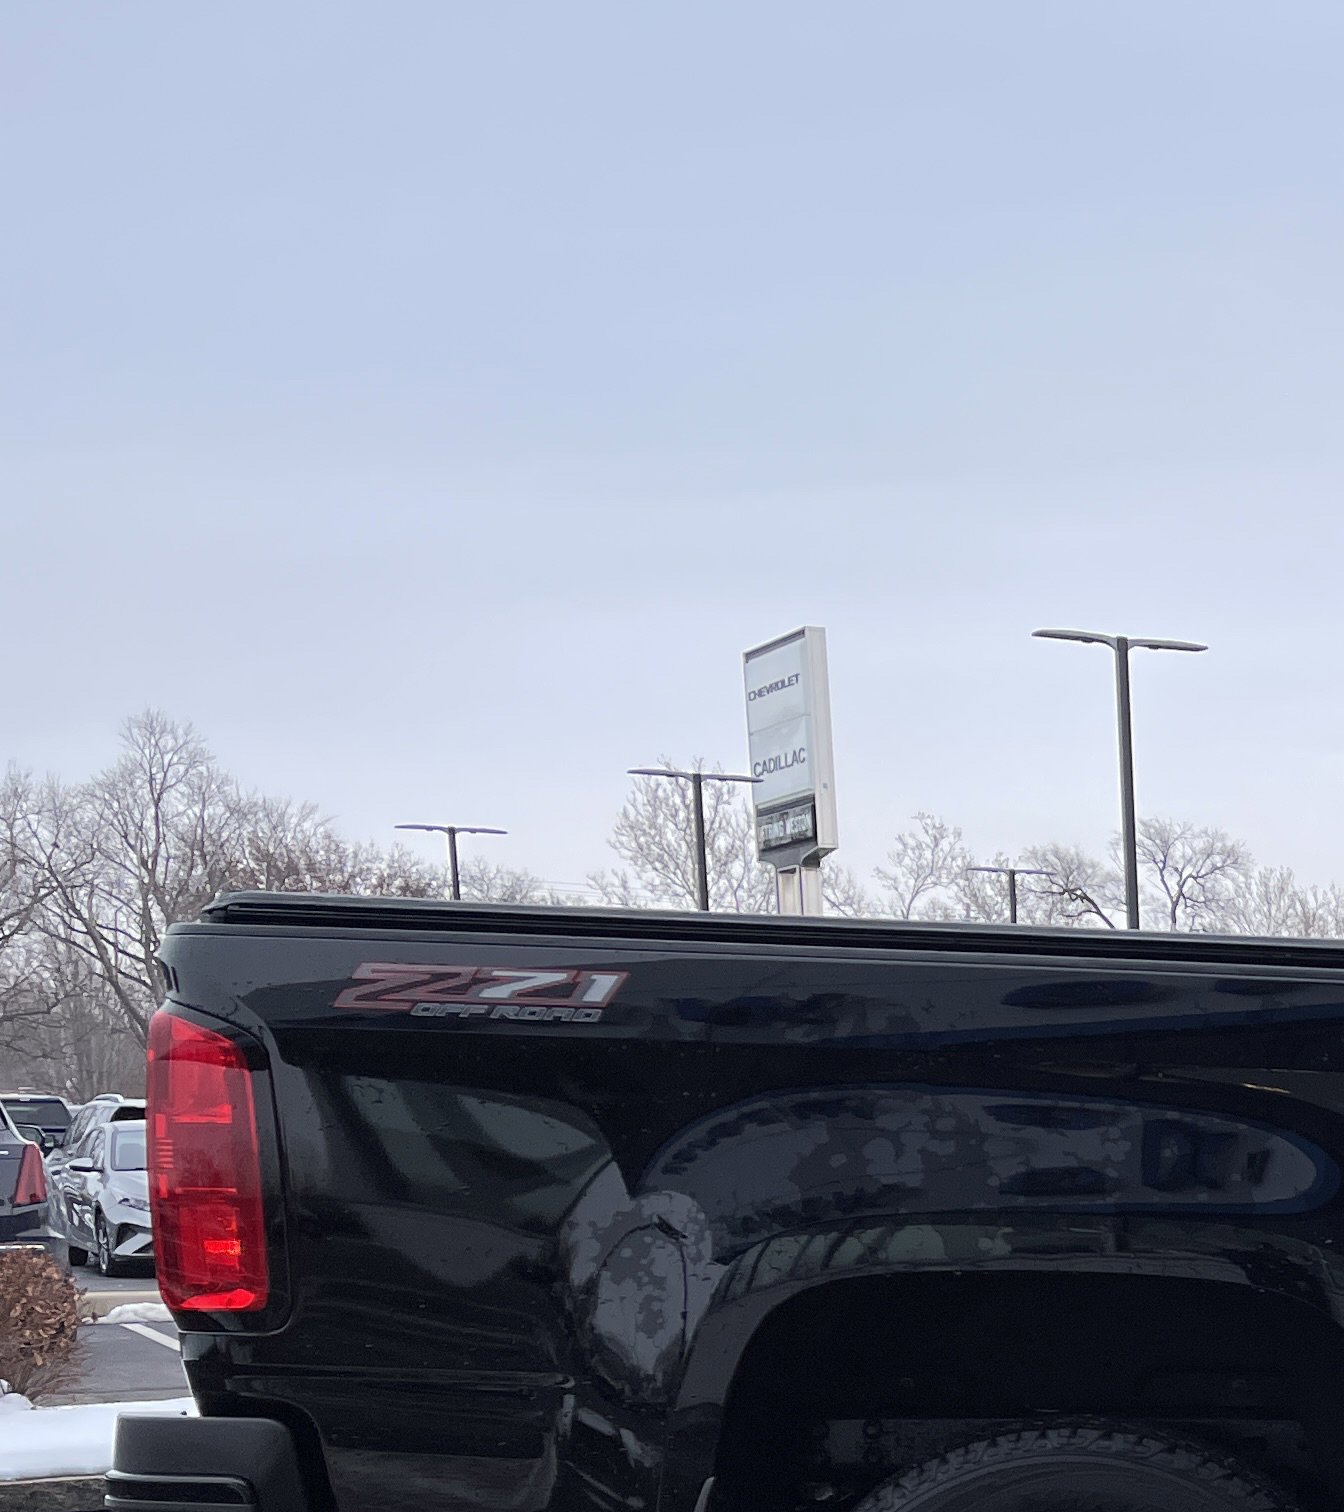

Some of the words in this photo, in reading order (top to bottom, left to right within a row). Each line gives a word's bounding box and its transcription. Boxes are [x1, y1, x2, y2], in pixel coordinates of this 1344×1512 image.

[748, 673, 800, 701] CHEVROLET
[753, 748, 806, 777] CADILLAC
[332, 961, 631, 1011] Z71
[410, 1002, 489, 1018] OFF
[489, 1004, 603, 1023] ROAD
